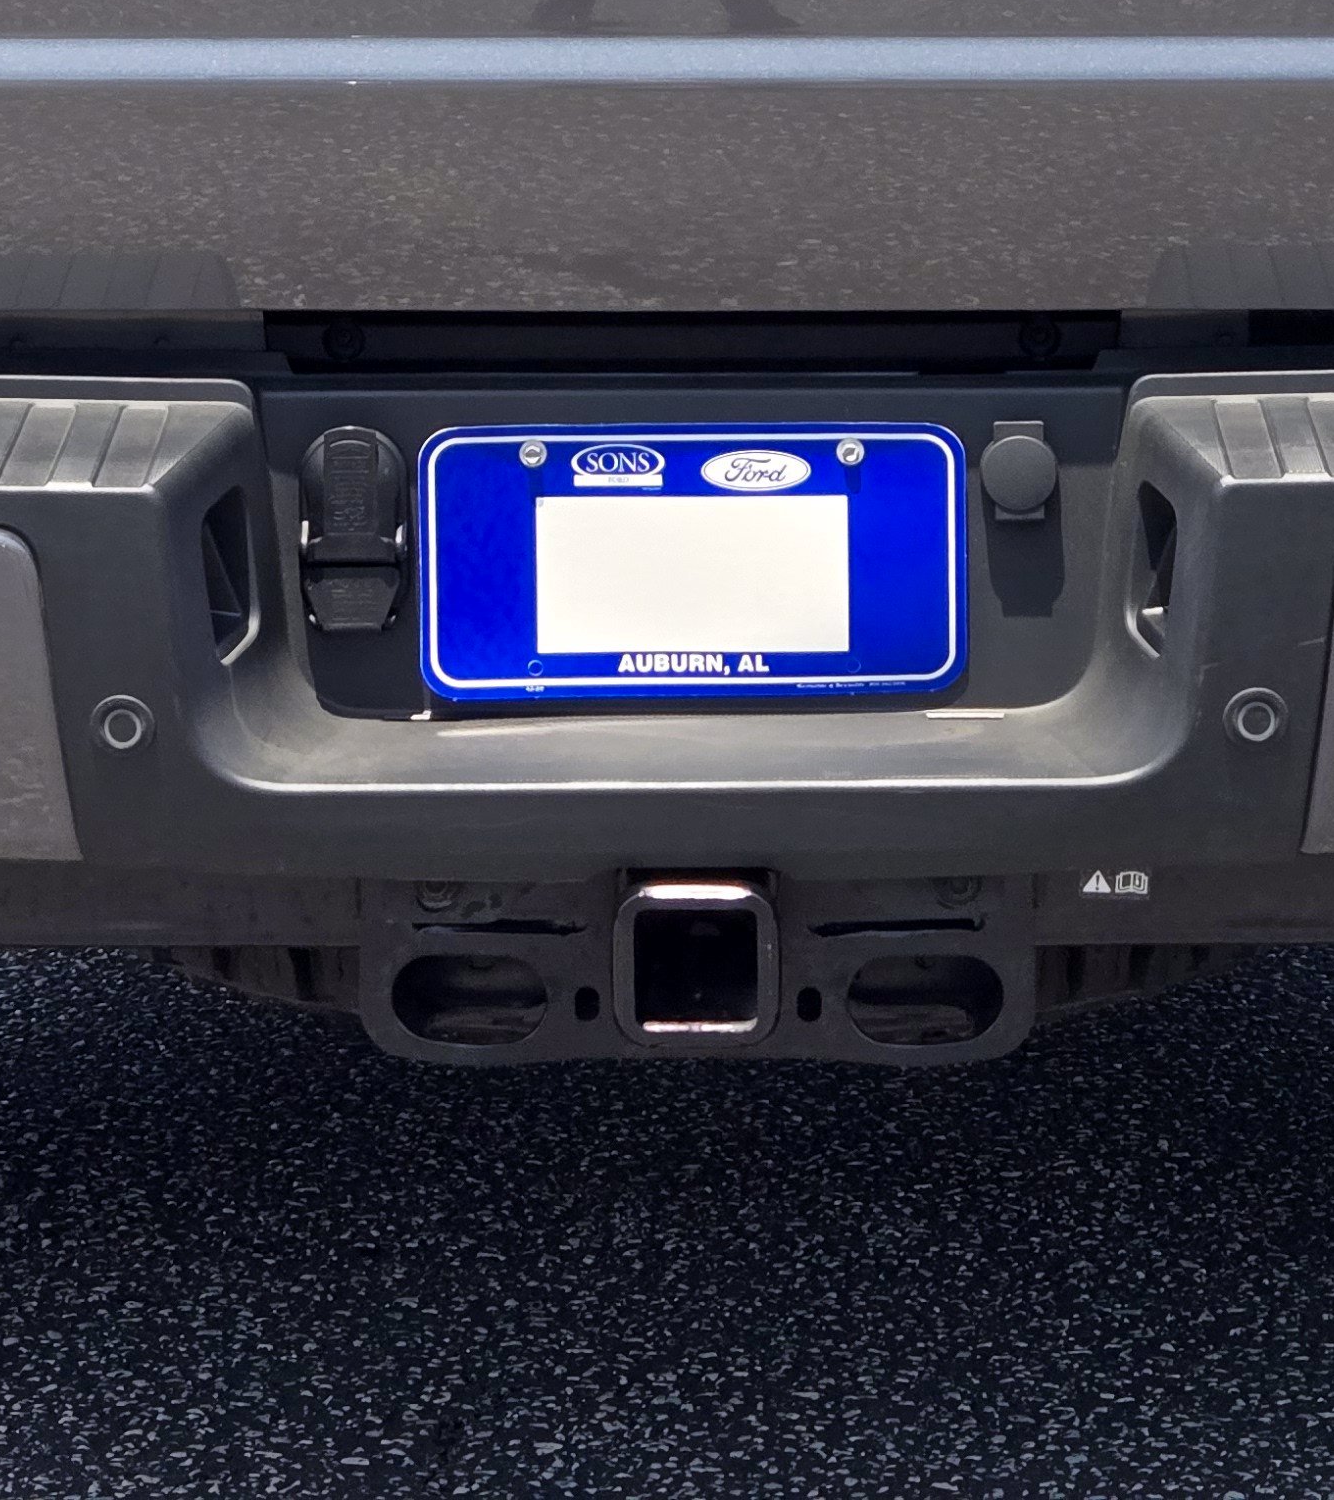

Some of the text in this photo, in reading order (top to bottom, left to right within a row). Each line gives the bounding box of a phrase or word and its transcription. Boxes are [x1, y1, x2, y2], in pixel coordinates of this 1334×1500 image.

[585, 452, 651, 474] SONS
[724, 457, 788, 483] Ford
[617, 653, 770, 676] AUBURN, AL
